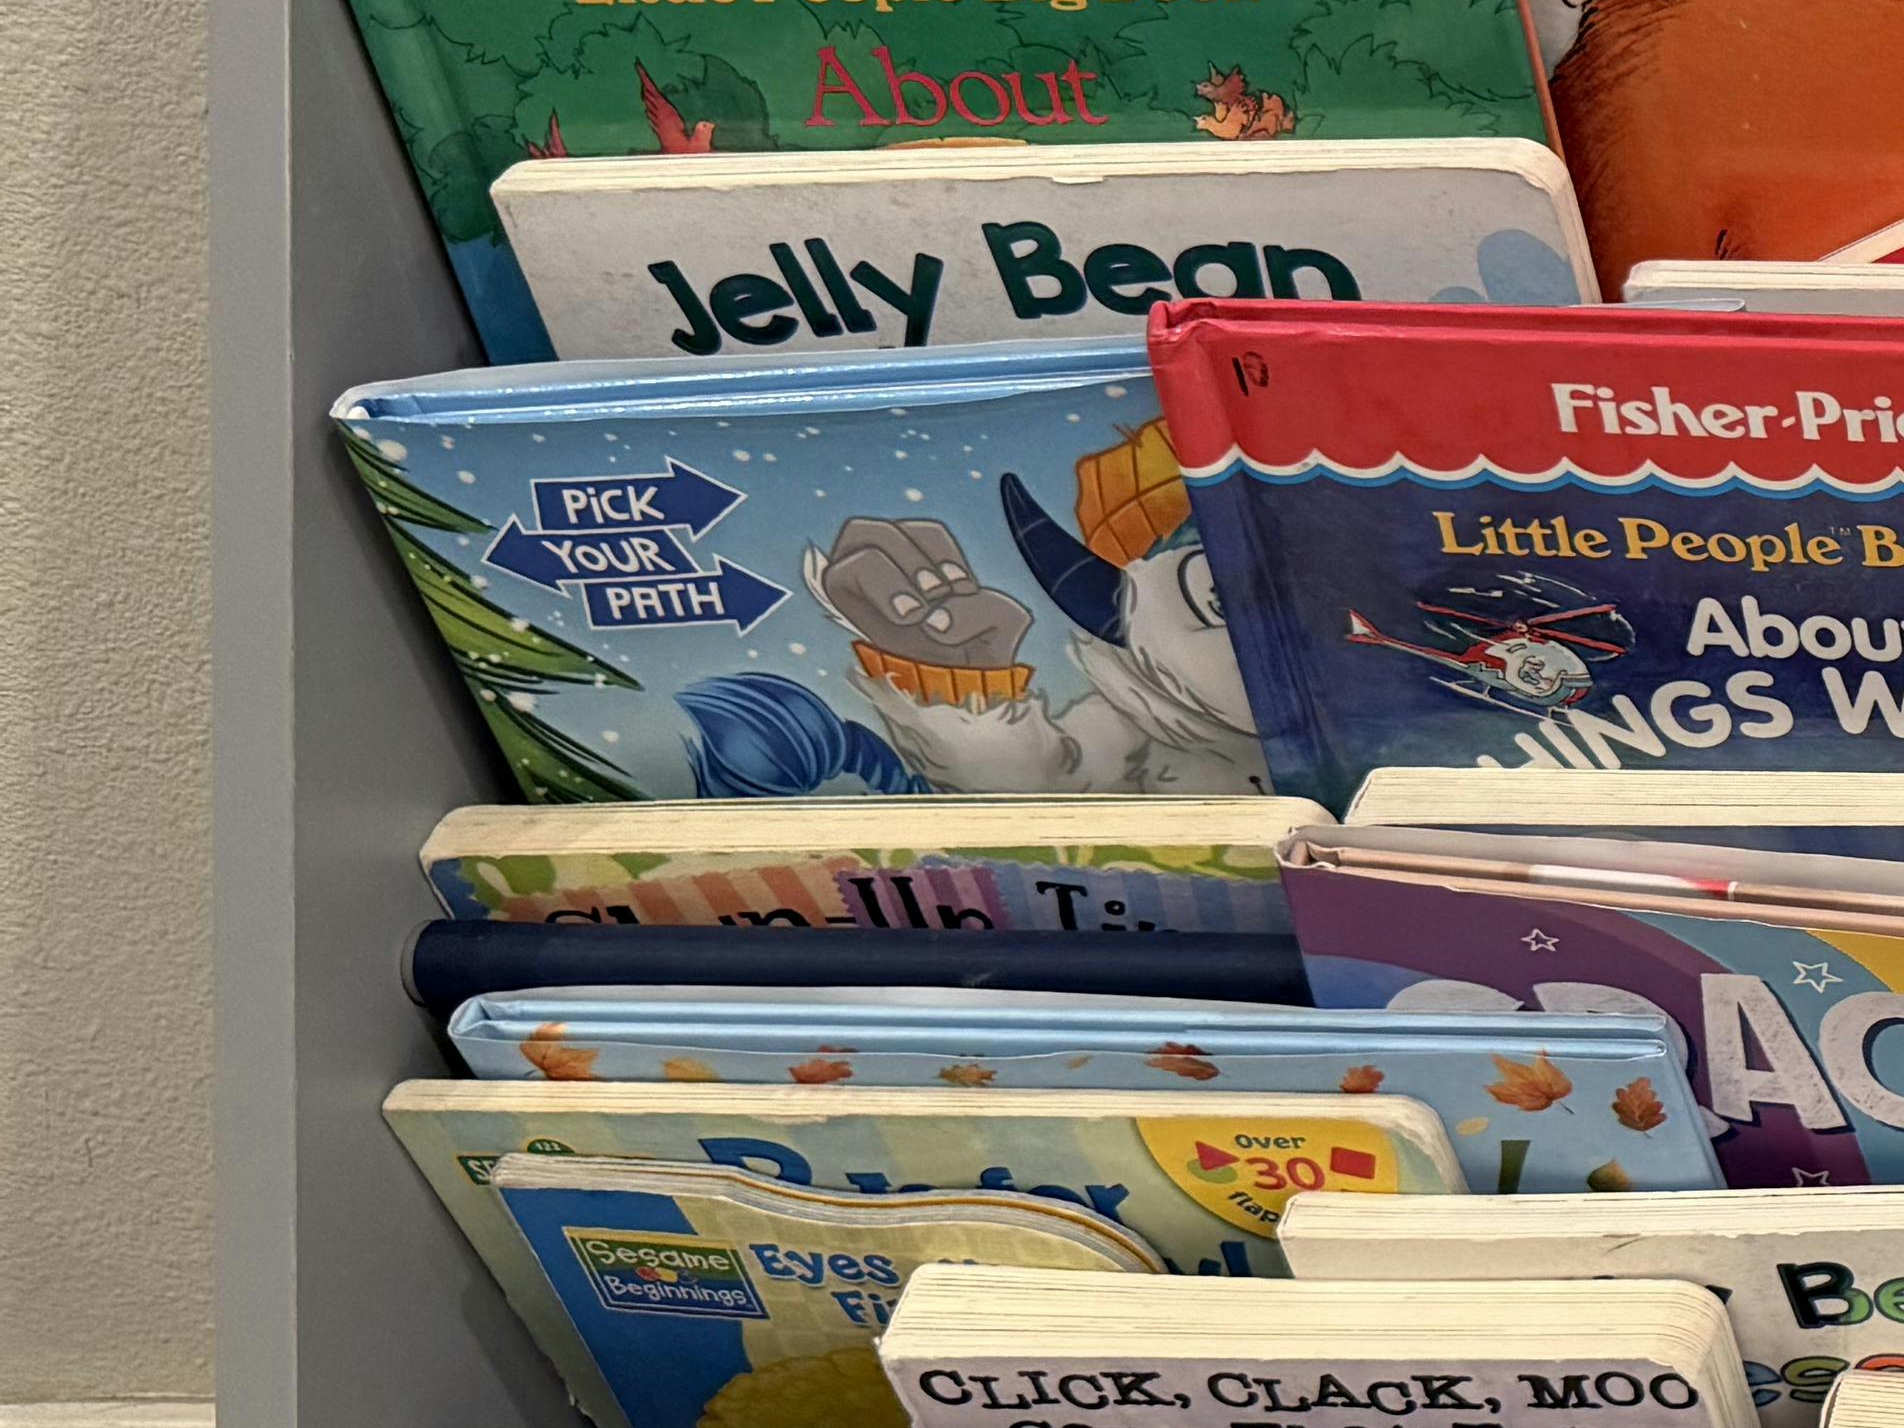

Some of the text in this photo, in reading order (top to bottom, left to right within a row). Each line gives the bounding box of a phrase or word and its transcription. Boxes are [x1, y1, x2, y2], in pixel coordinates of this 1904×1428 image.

[805, 43, 1110, 129] About
[647, 219, 1362, 356] Jelly Bean
[1432, 510, 1622, 559] Little
[551, 535, 671, 575] YOUR
[606, 583, 723, 621] PATH
[1234, 1131, 1307, 1152] over
[1254, 1155, 1327, 1192] 30
[1227, 1188, 1281, 1225] flap
[584, 1239, 731, 1271] Sesame
[748, 1243, 902, 1288] Eyes
[604, 1274, 747, 1307] Beginnings
[917, 1368, 1700, 1416] CLICK, CLACK, MOO
